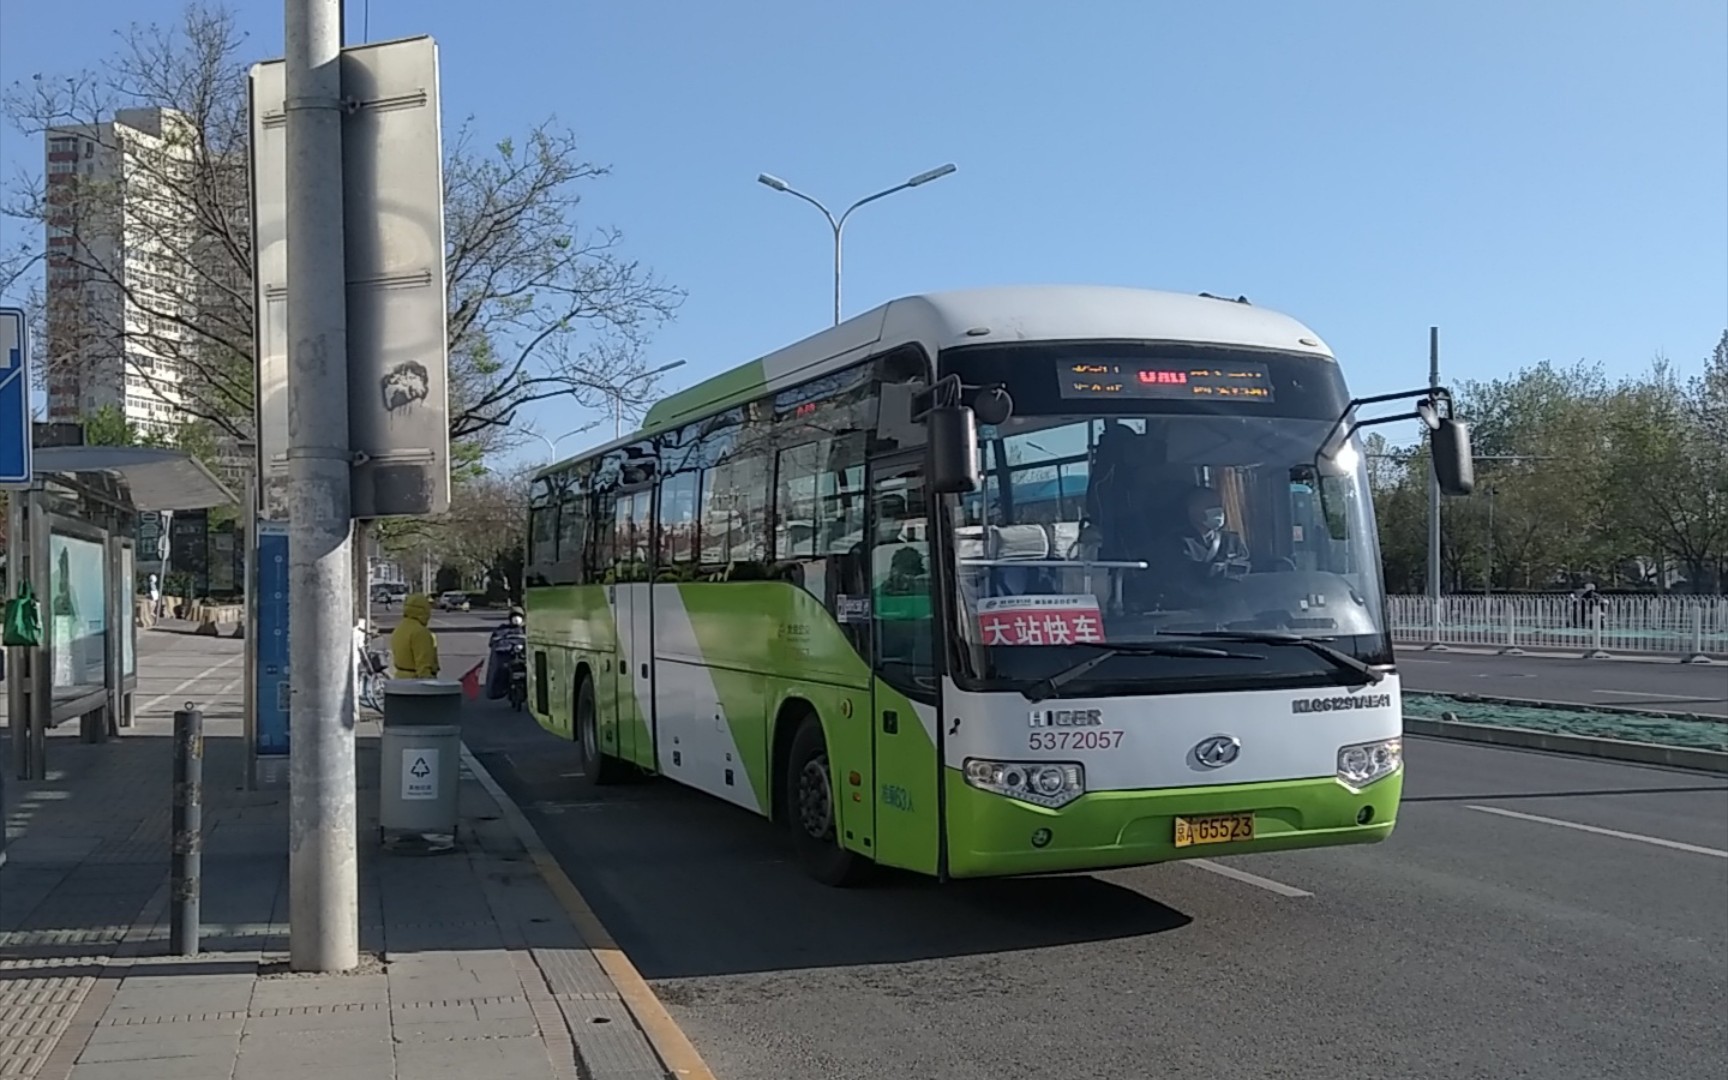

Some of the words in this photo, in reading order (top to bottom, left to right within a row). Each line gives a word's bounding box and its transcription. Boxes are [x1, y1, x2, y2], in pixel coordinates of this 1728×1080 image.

[984, 614, 1101, 646] 大站快车
[1028, 709, 1103, 727] HIGER
[1029, 731, 1124, 750] 5372057
